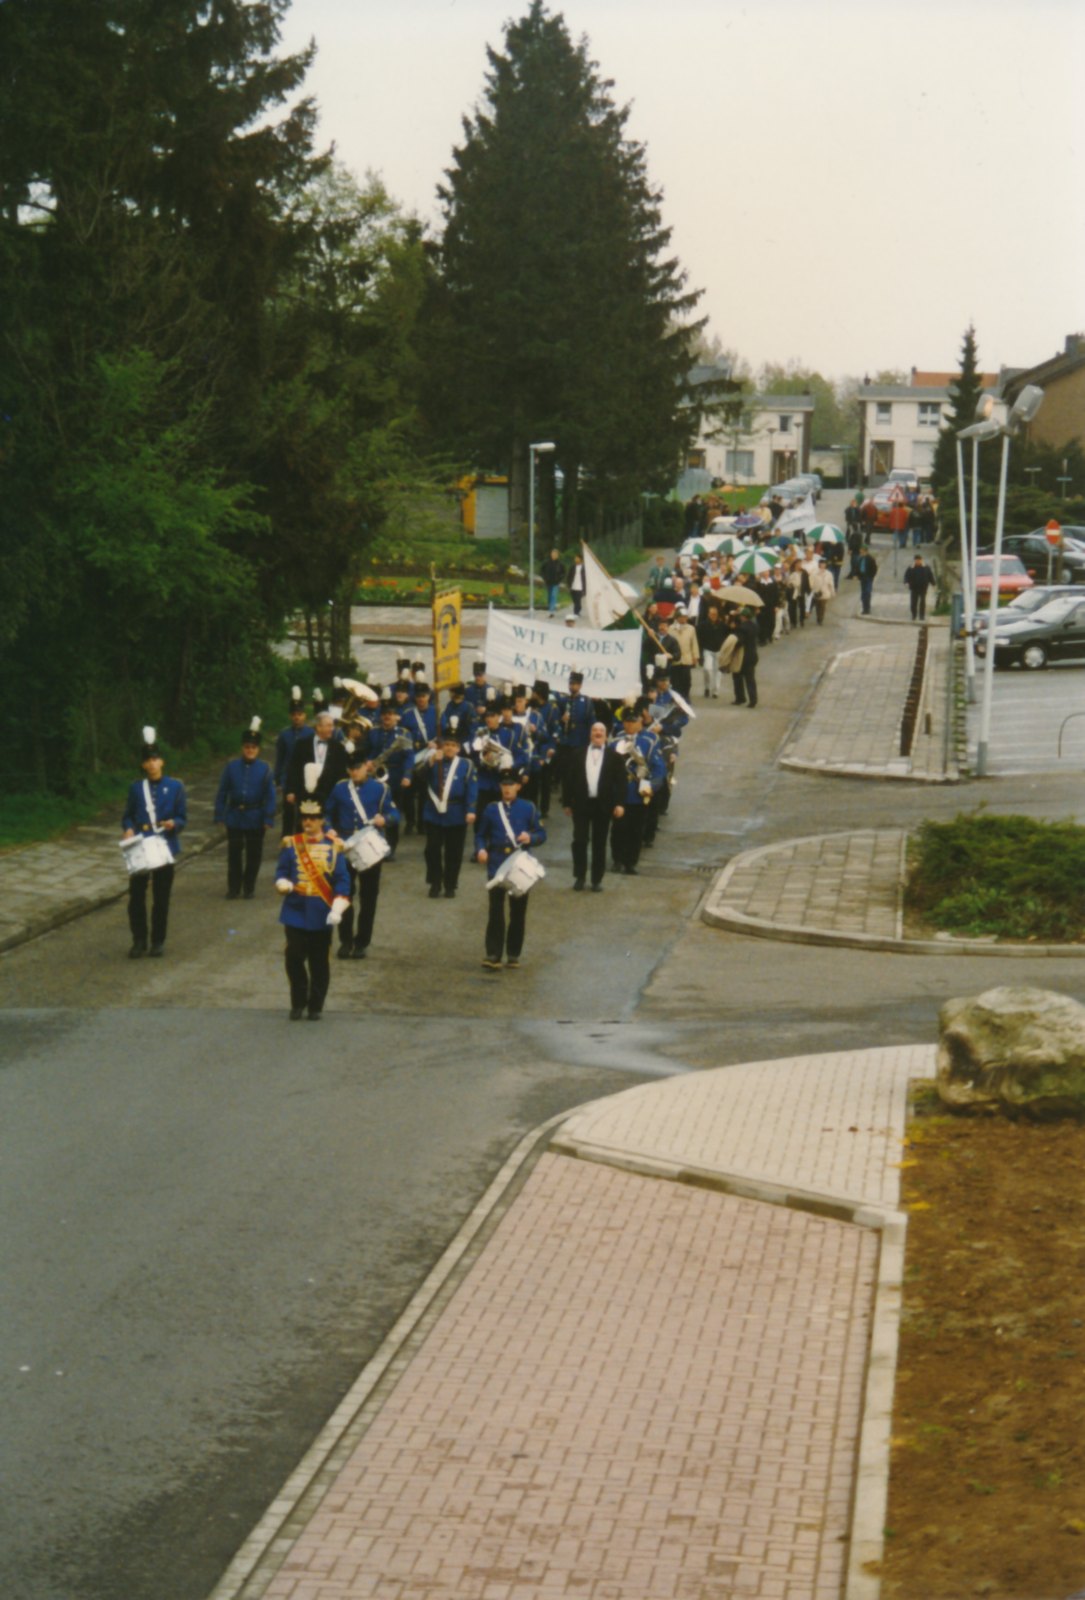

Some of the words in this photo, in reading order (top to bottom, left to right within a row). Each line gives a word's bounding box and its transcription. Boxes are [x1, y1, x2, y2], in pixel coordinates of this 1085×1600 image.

[512, 625, 549, 646] WIT
[561, 636, 626, 656] GROEN
[513, 652, 618, 681] KAMPOEN
